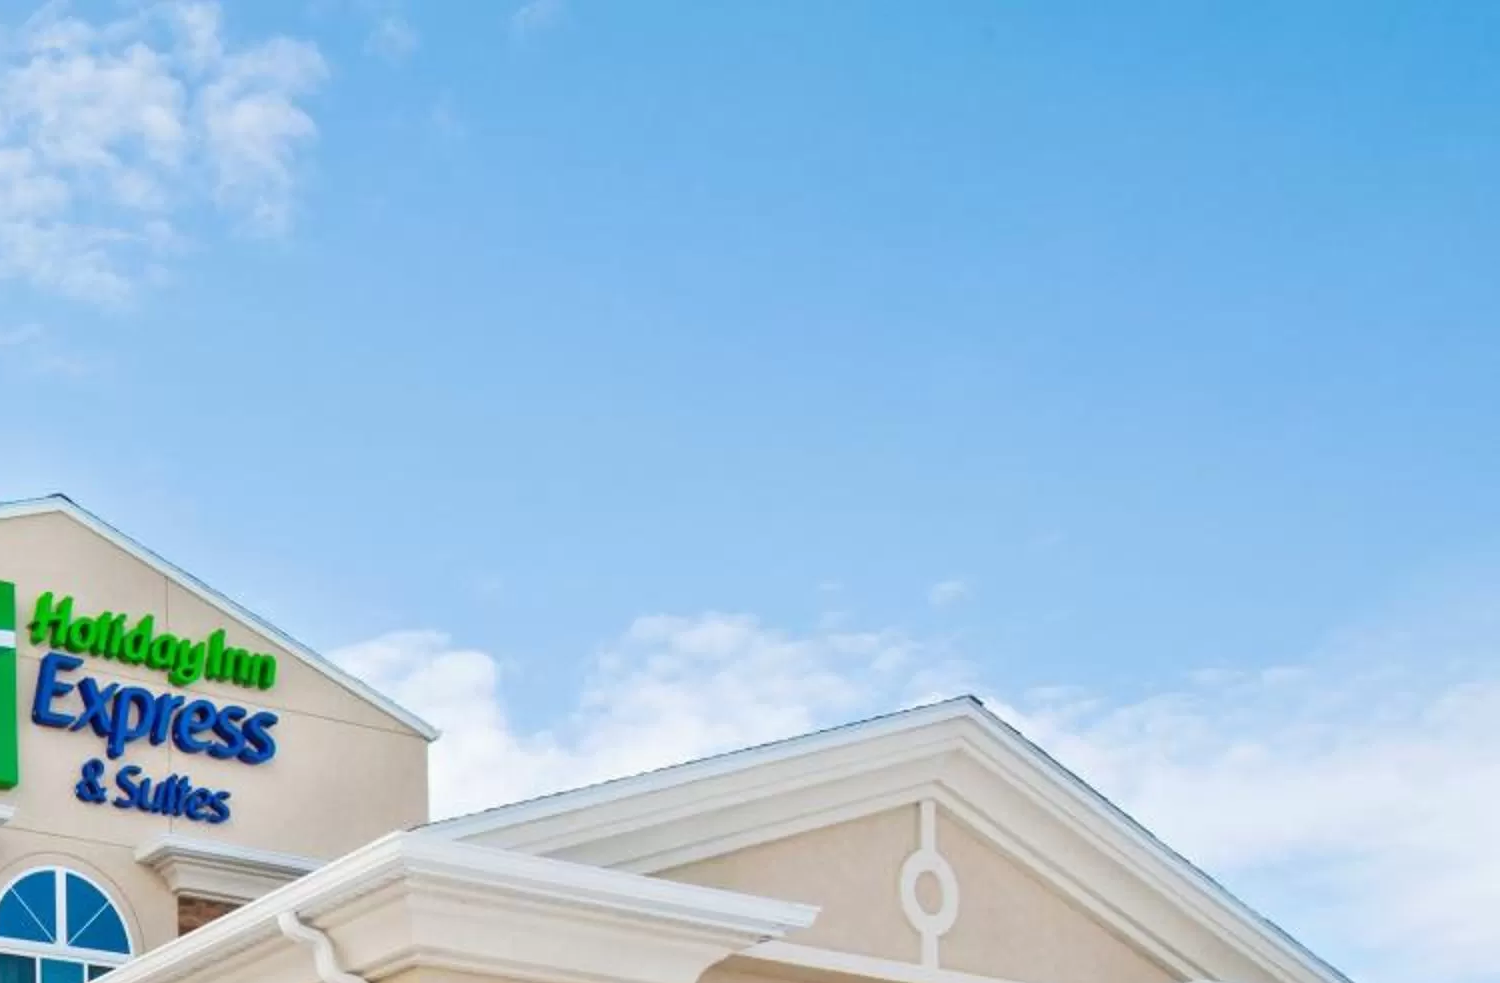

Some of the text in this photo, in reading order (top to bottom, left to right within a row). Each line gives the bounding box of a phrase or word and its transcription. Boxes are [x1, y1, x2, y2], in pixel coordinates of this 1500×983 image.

[28, 591, 277, 690] Holiday Inn
[31, 651, 279, 765] Express
[75, 758, 231, 824] & Suites
